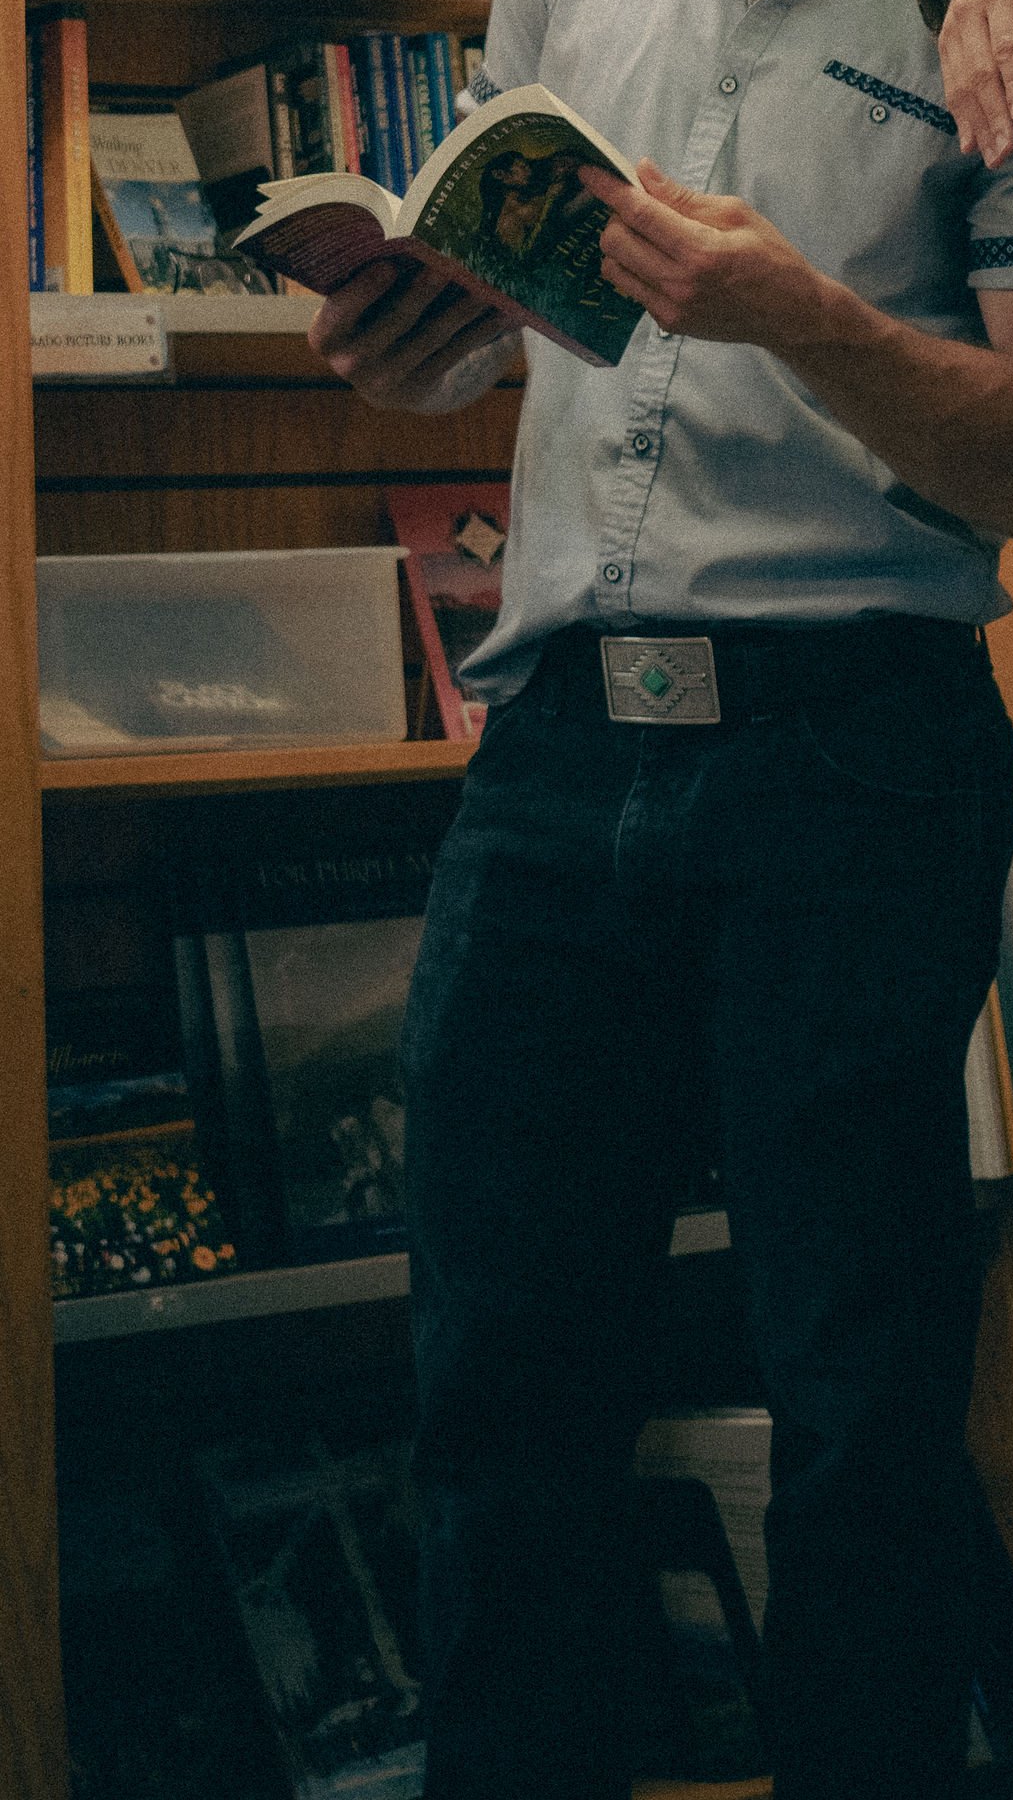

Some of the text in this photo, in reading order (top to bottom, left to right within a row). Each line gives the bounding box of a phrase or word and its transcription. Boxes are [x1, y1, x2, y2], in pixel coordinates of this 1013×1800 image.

[425, 142, 488, 227] KIMBERLY
[65, 335, 111, 347] PICTURE
[117, 335, 154, 345] BOOKS
